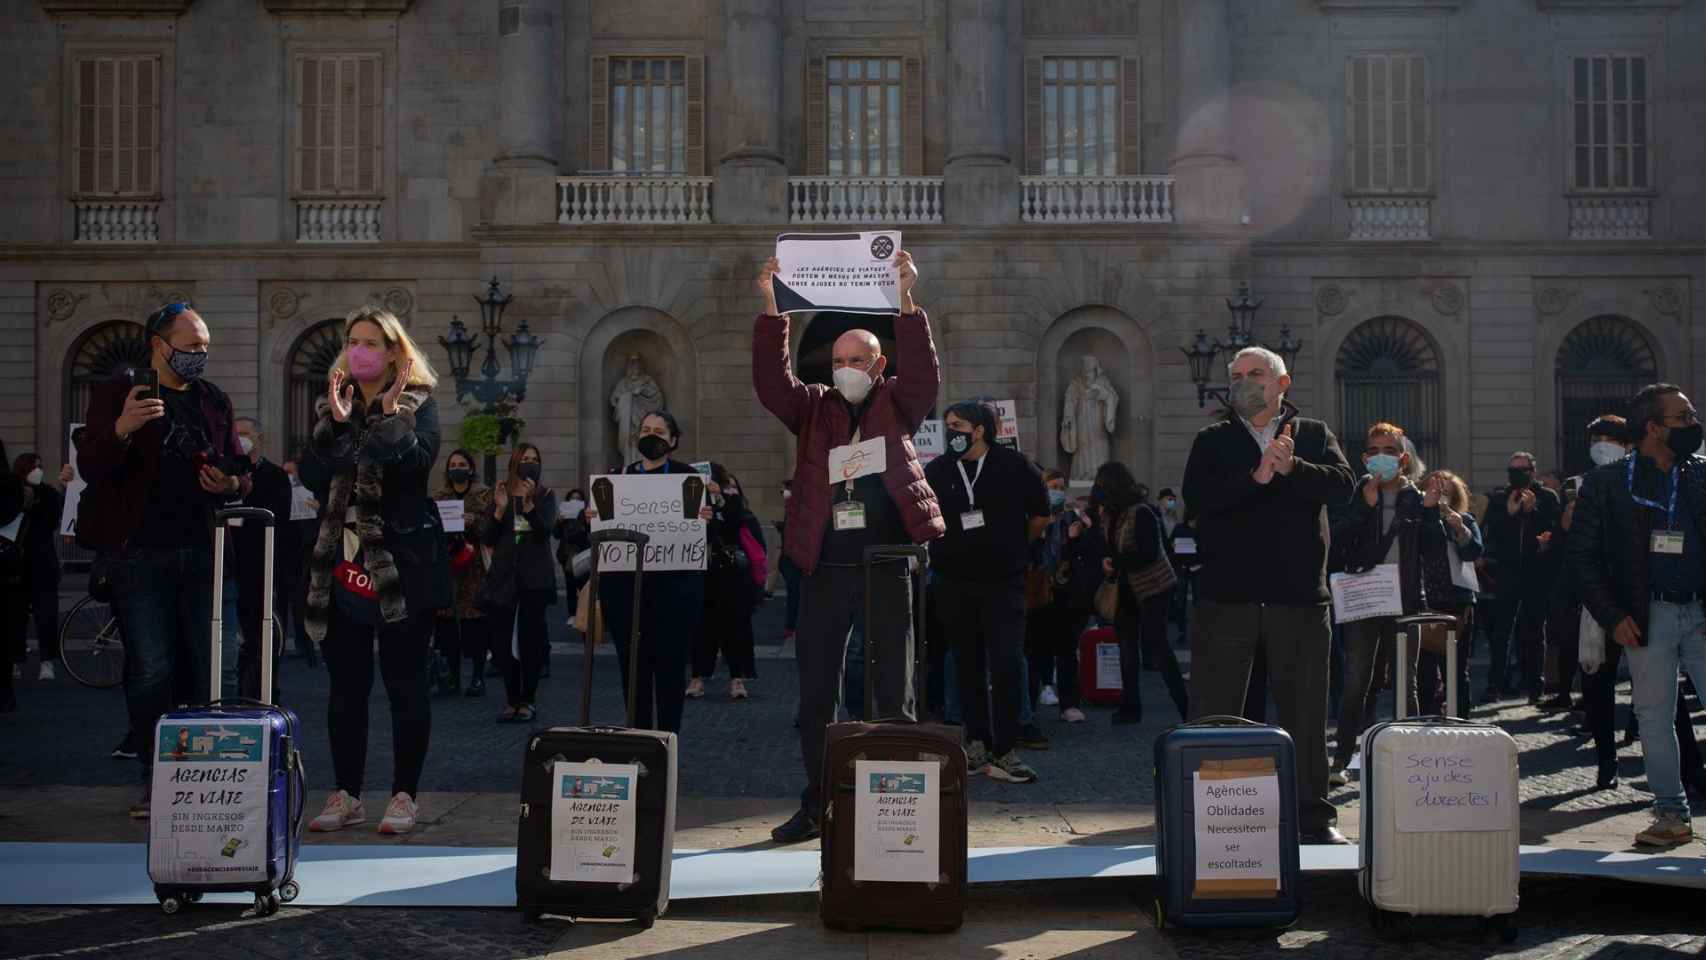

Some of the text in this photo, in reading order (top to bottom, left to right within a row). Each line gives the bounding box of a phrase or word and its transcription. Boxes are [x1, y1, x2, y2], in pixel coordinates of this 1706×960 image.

[620, 498, 681, 516] Sense
[600, 543, 621, 563] NO
[626, 543, 675, 564] PDEM
[170, 767, 248, 783] AGENCIAS
[1407, 770, 1473, 791] ajudes
[1206, 784, 1258, 798] Agències
[171, 789, 243, 805] DE VIAJE
[570, 801, 620, 813] AGENCIAS
[1207, 805, 1265, 816] Oblidades
[171, 812, 245, 821] SIN INGRESOS
[877, 809, 890, 817] DE
[570, 816, 617, 826] DE VIAJE
[171, 824, 245, 833] DESDE MARZO
[1207, 825, 1266, 834] Necessitem
[1225, 844, 1241, 852] ser
[1208, 858, 1263, 869] escoltades
